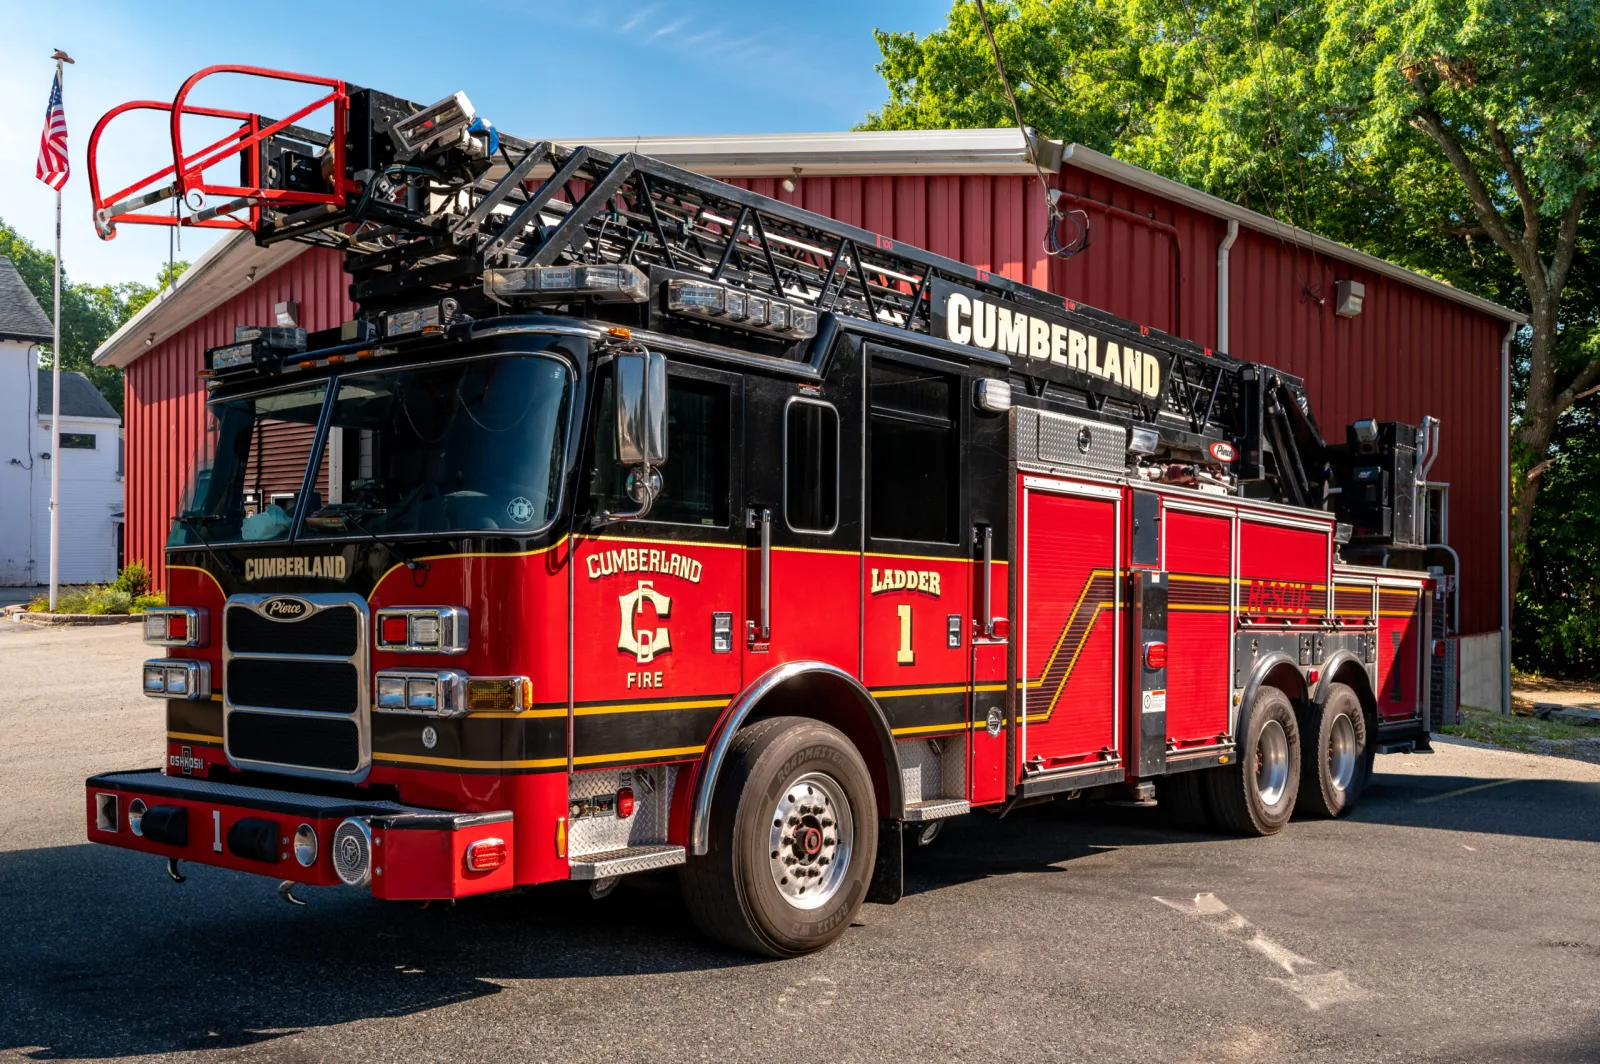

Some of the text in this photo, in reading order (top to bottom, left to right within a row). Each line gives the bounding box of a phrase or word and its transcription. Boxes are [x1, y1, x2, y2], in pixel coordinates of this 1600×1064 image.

[881, 239, 893, 251] 100
[946, 292, 1160, 399] CUMBERLAND
[245, 555, 346, 580] CUMBERLAND
[586, 548, 703, 584] CUMBERLAND
[871, 568, 941, 598] LADDER
[1247, 580, 1313, 614] RESCUE
[269, 601, 301, 615] Pierce
[897, 604, 915, 666] 1
[627, 671, 664, 690] FIRE
[169, 755, 205, 770] OSHKOSH
[212, 809, 223, 853] 1
